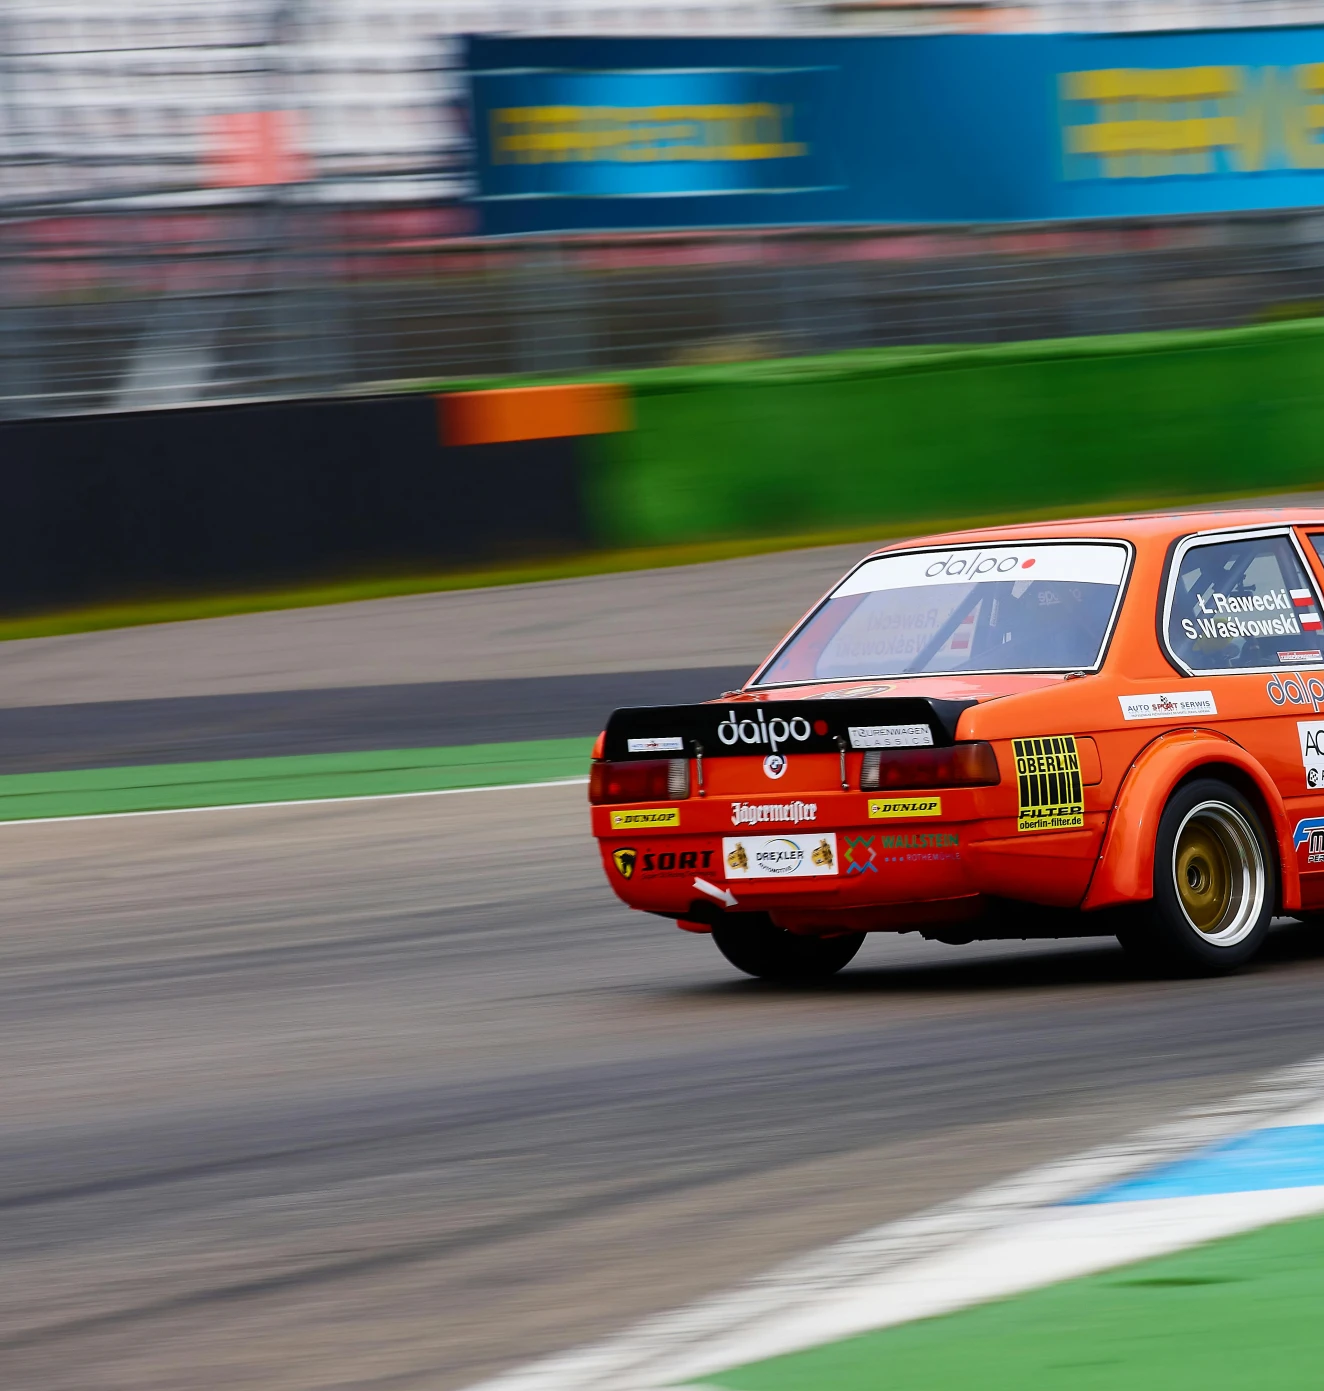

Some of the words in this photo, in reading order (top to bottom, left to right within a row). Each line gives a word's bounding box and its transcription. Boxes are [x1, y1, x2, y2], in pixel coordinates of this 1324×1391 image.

[925, 552, 1019, 581] dalpo
[1152, 702, 1178, 711] SPORT
[1180, 700, 1211, 708] SERWIS
[717, 708, 811, 752] dalpo
[852, 727, 929, 738] TOURENWAGEN
[854, 737, 930, 747] CLASSICS
[1017, 755, 1079, 774] OBERLIN
[882, 802, 937, 812] DUNLOP
[1020, 806, 1082, 819] FILTER
[623, 813, 676, 823] DUNLOP
[1020, 816, 1082, 829] oberlin-filter.de
[881, 833, 959, 848] WALLSTEIN
[641, 850, 714, 871] SORT
[756, 851, 805, 863] DREXLER
[758, 862, 793, 873] AUTOMOTIVE
